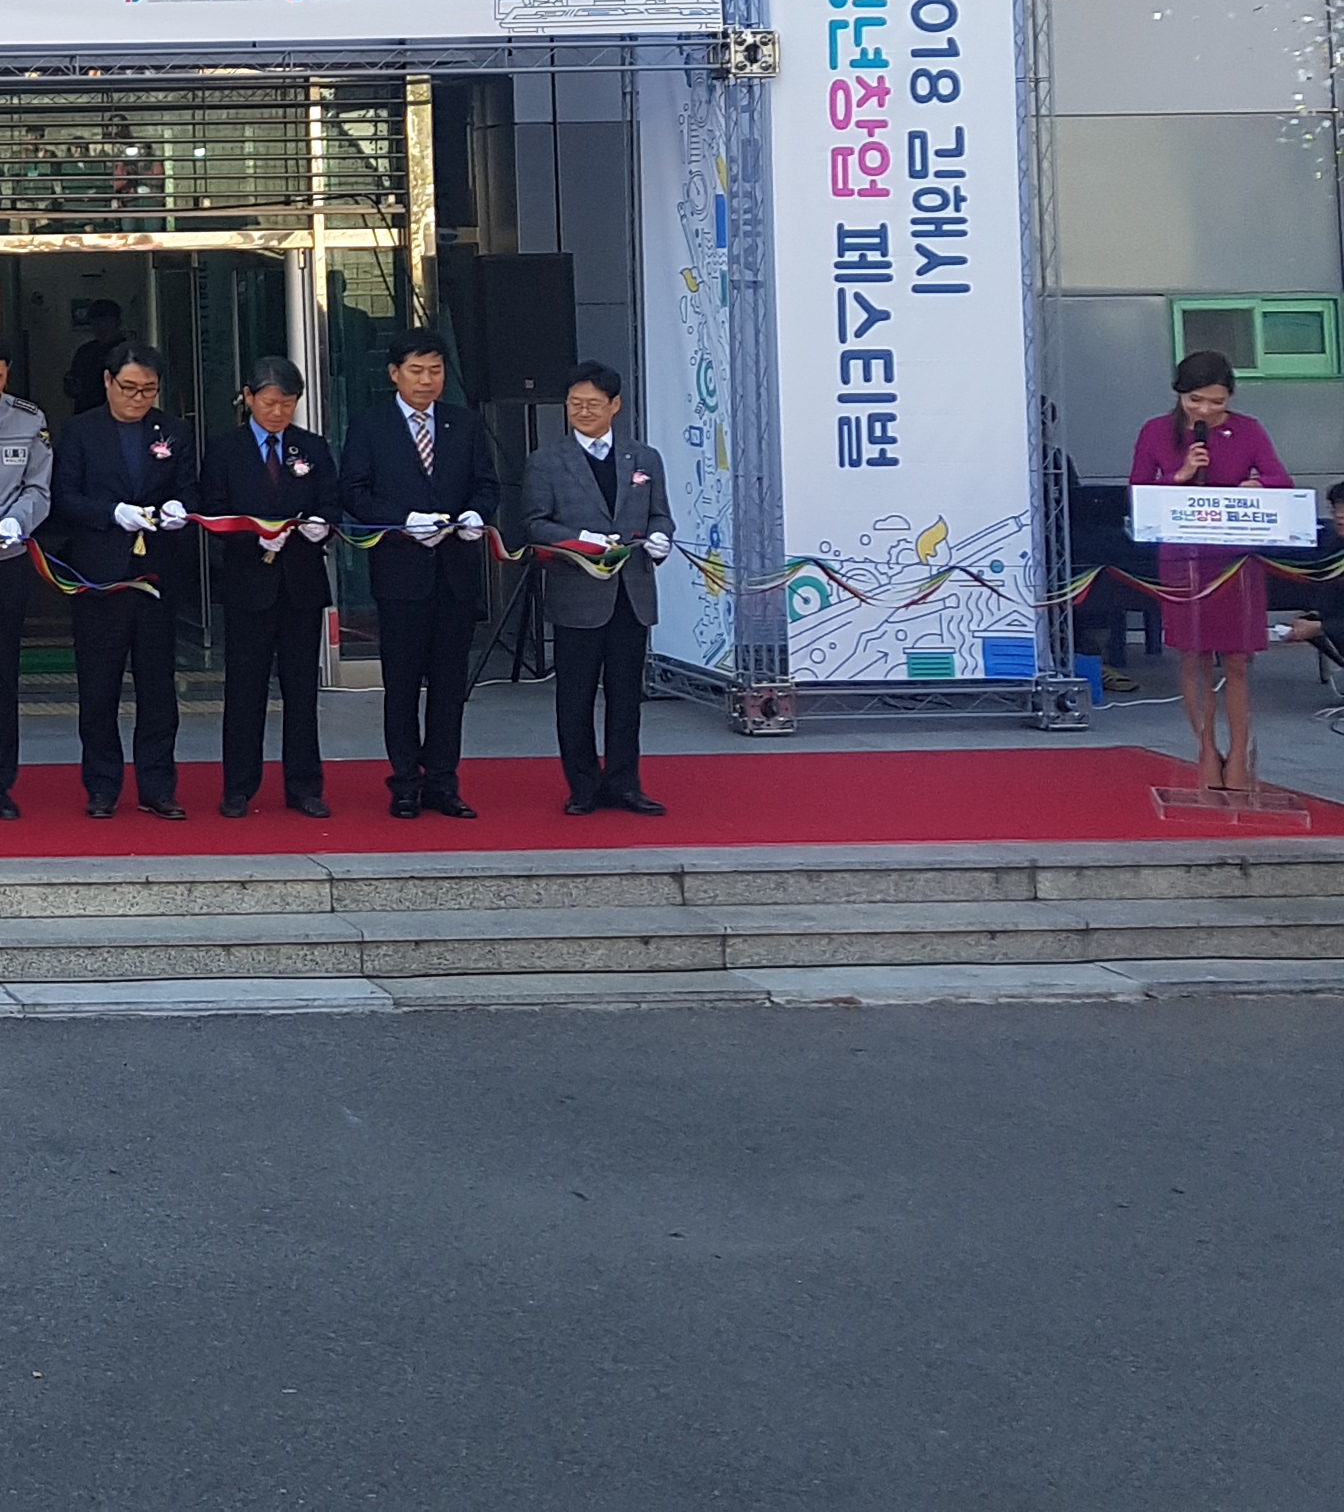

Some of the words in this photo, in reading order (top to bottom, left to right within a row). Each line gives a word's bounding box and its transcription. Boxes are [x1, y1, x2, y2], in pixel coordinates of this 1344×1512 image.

[907, 125, 972, 296] 김해시
[832, 220, 900, 470] 페스티벌
[1188, 497, 1220, 508] 2018
